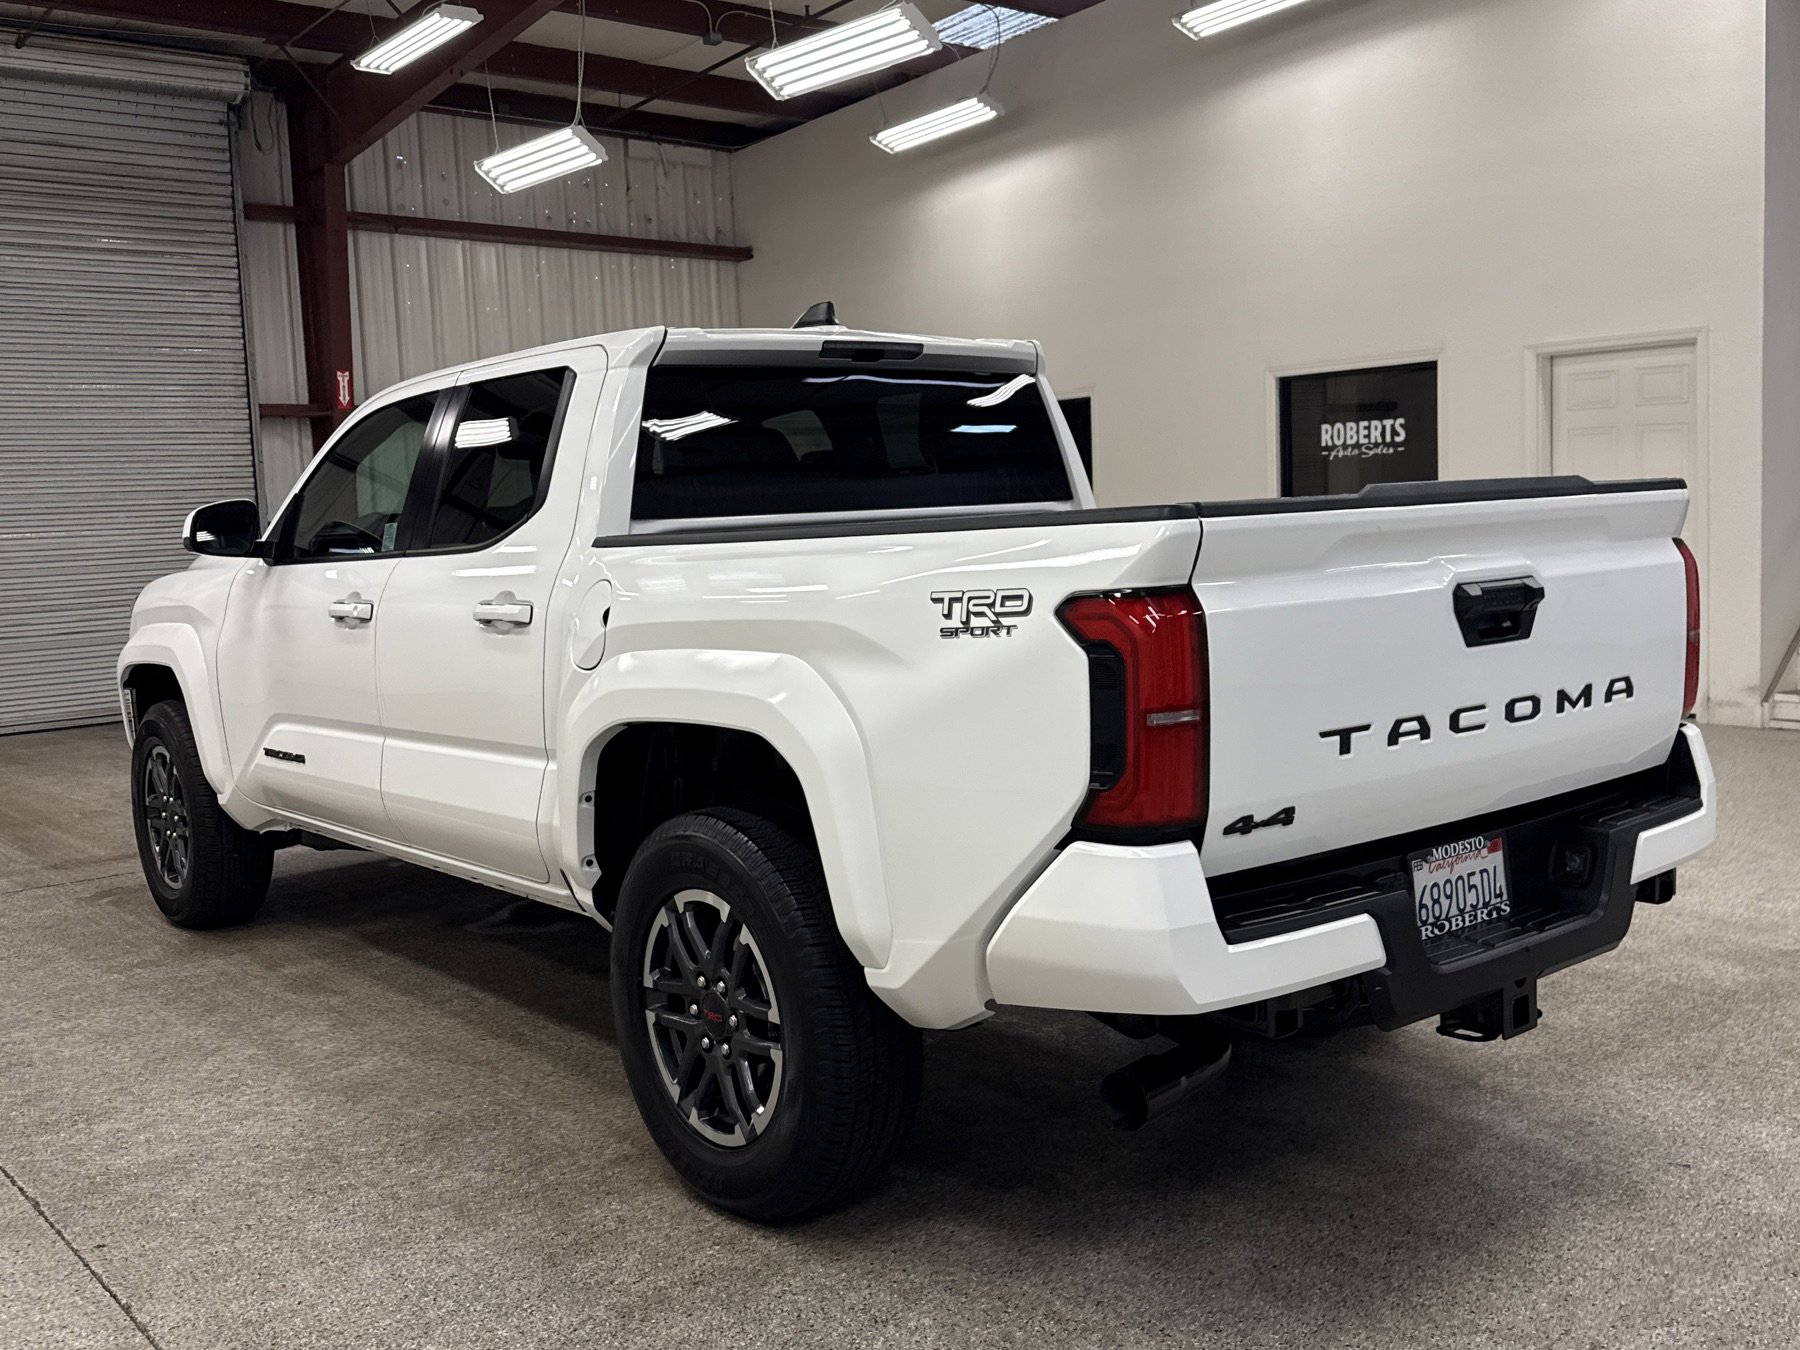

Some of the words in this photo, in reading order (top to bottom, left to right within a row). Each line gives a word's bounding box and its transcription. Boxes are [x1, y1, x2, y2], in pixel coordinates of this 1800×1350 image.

[1321, 418, 1406, 447] ROBERTS
[1329, 446, 1359, 460] Auto
[1361, 444, 1394, 458] Sales
[930, 588, 1034, 626] TRD
[940, 625, 1018, 639] SPORT
[1319, 676, 1635, 757] TACOMA
[1428, 848, 1489, 874] California
[1431, 836, 1485, 861] MODESTO
[1418, 864, 1504, 926] 68905D4
[1420, 900, 1511, 940] ROBERTS
